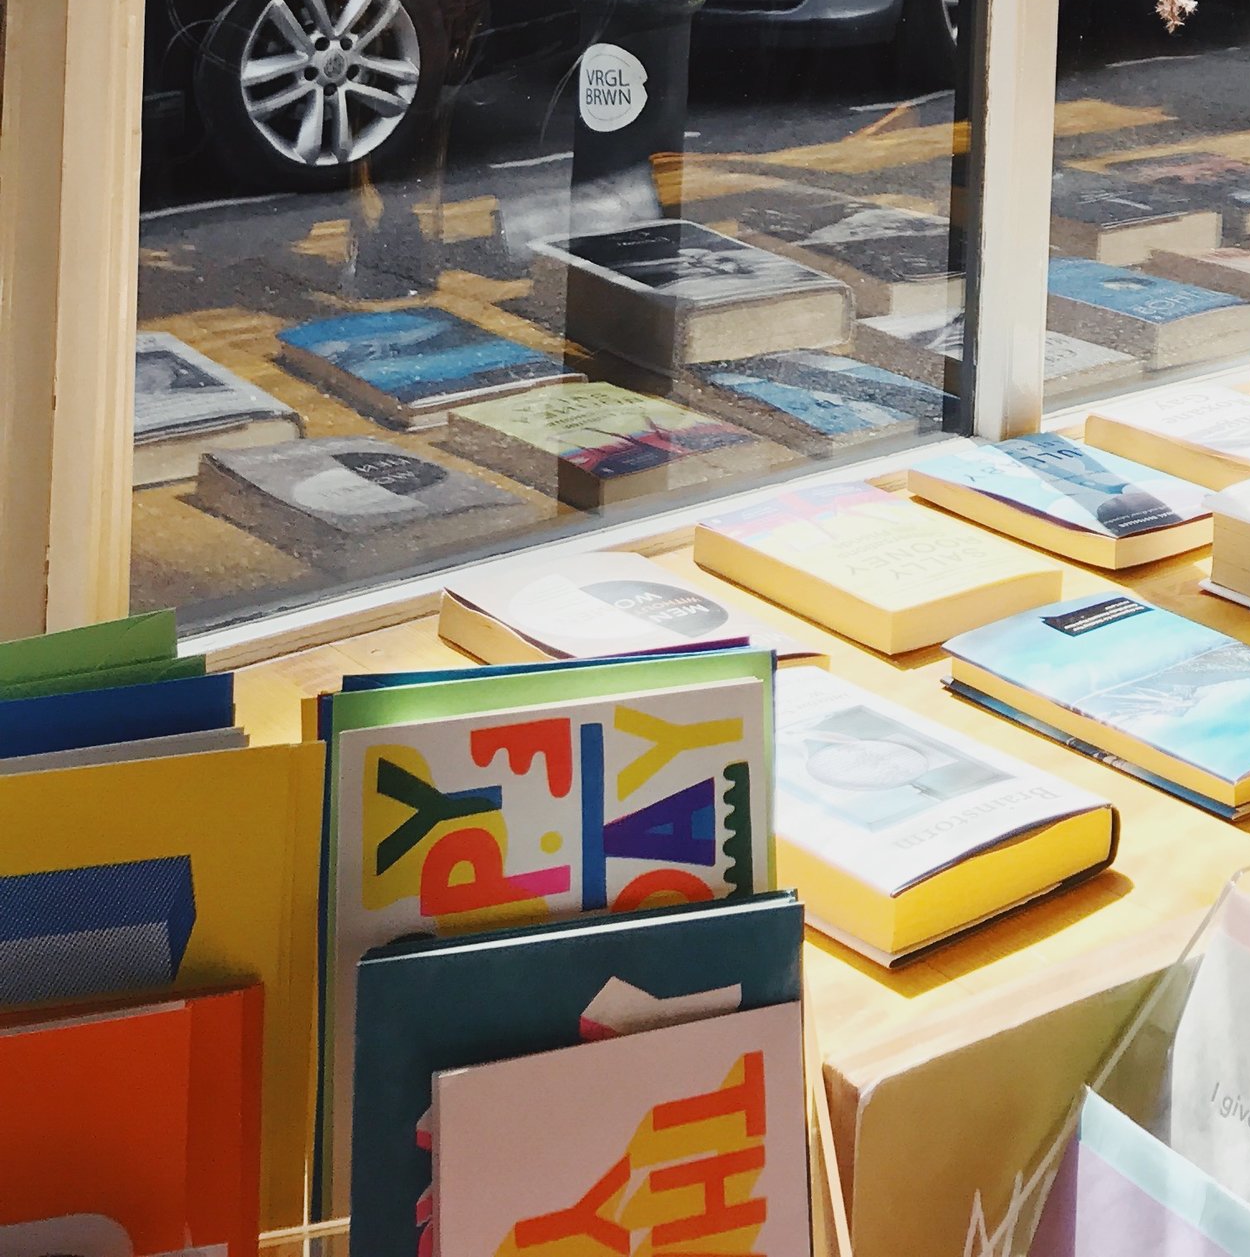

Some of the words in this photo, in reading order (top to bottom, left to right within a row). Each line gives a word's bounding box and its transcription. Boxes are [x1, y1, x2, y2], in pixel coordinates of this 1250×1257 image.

[586, 69, 630, 87] VRGL
[586, 88, 631, 105] BRWN
[649, 603, 710, 623] MEN
[895, 786, 1060, 851] Brainstorm
[1210, 1082, 1220, 1102] I
